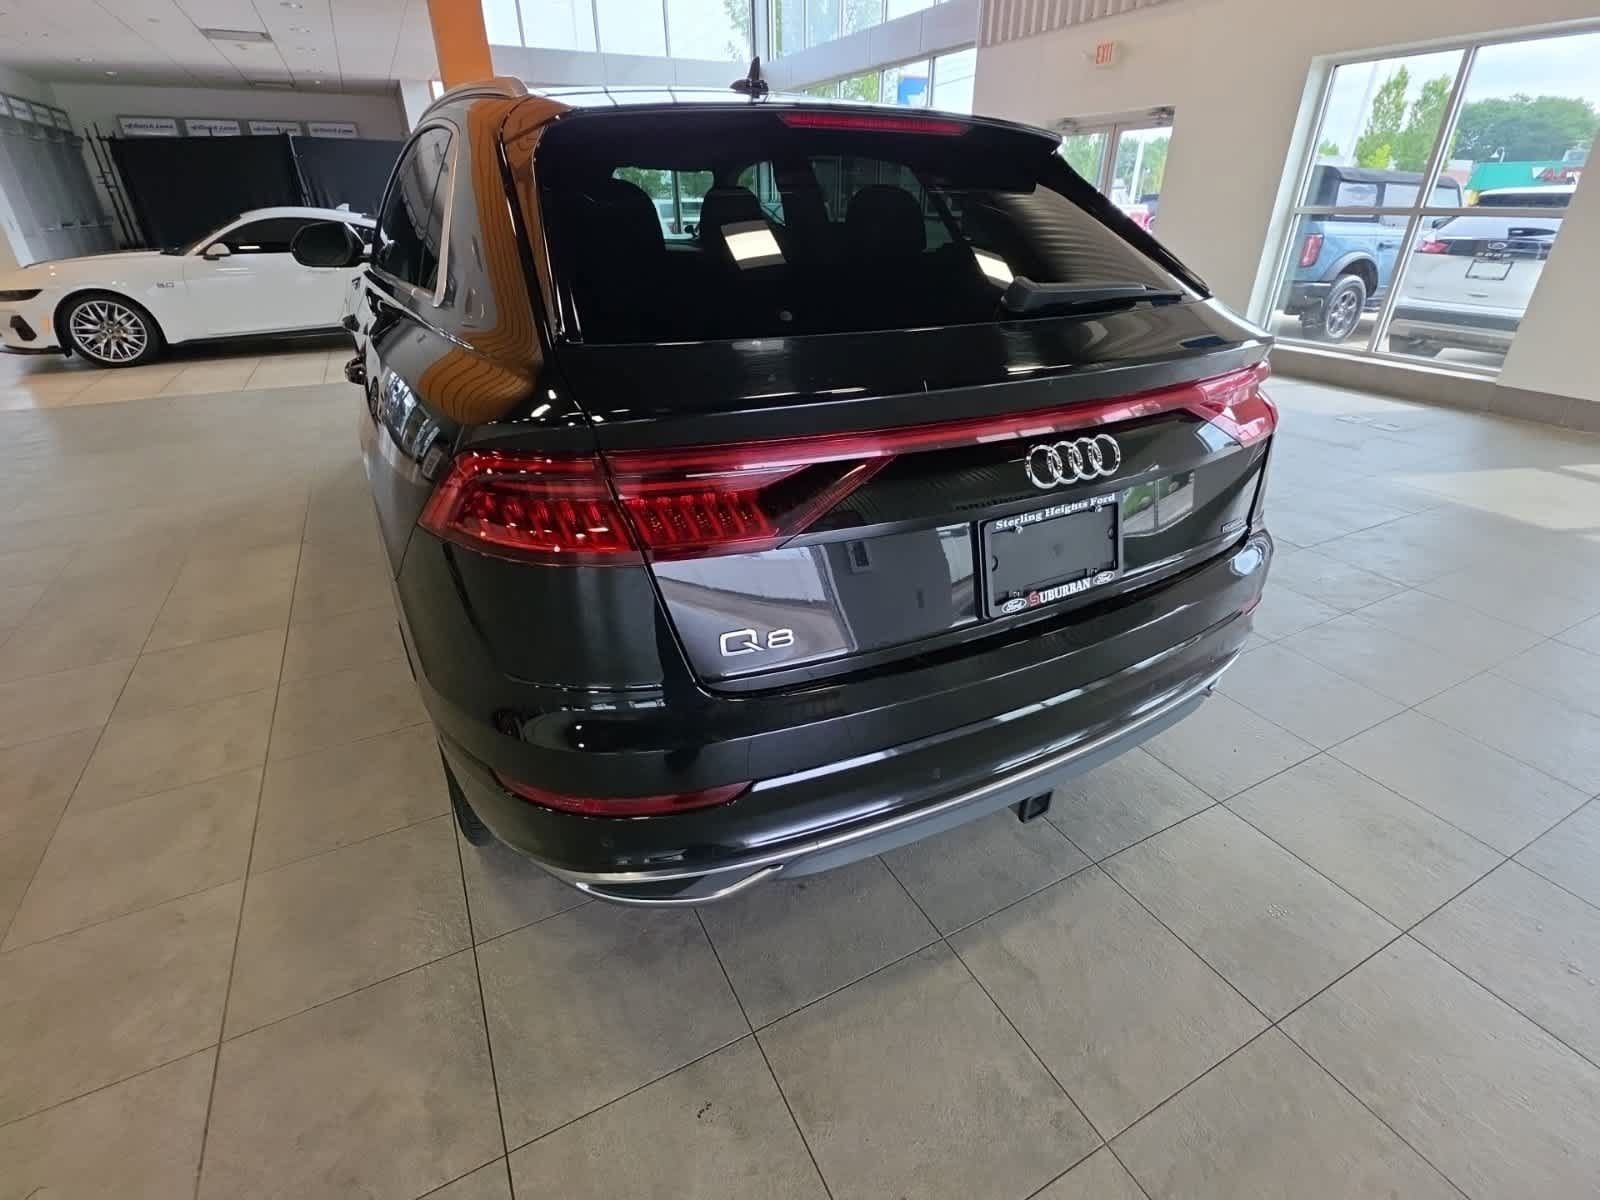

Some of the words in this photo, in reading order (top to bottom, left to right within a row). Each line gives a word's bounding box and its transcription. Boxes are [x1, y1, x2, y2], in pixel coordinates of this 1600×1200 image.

[1096, 42, 1113, 64] EXIT
[995, 512, 1042, 529] Sterling
[1045, 500, 1088, 517] Heights
[1090, 493, 1115, 506] Ford
[1029, 578, 1091, 607] SUBURBAN
[719, 627, 795, 656] Q8
